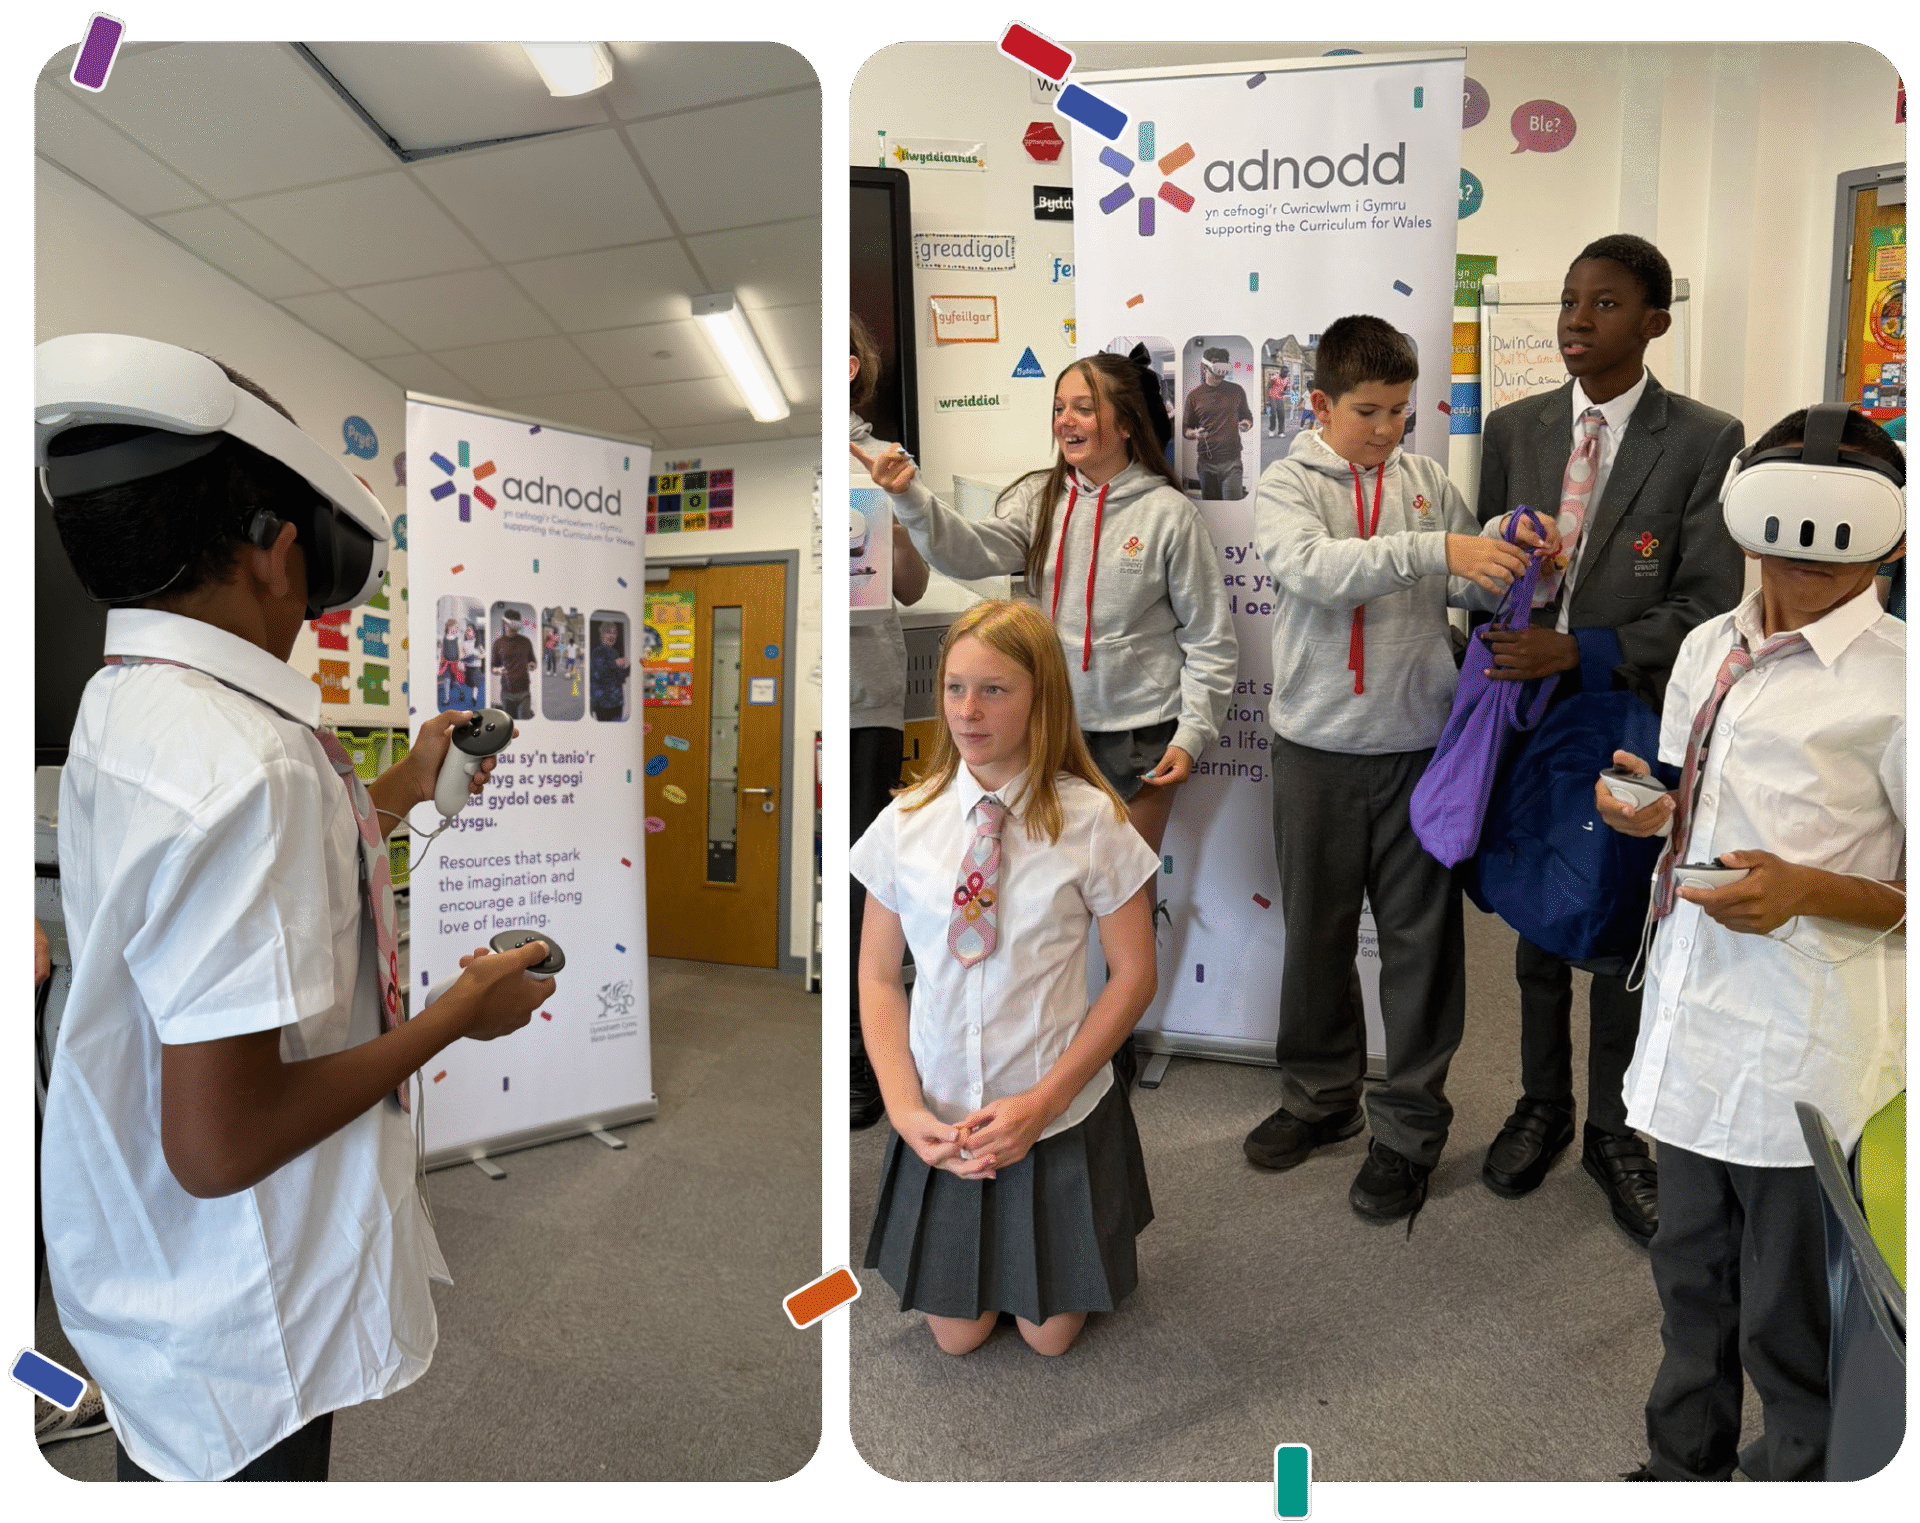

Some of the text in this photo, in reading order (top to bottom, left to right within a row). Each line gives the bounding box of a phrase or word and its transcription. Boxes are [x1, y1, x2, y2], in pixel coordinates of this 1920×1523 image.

[1530, 115, 1561, 133] Ble?
[1204, 142, 1406, 193] adnodd
[1205, 198, 1406, 221] yn cefnogi'r Cwricwlwm i Gymru
[1205, 215, 1433, 237] supporting the Curriculum for Wales
[920, 239, 1011, 262] greadigol
[938, 311, 991, 324] gyfeillgar
[939, 394, 1000, 408] wreiddiol
[1451, 403, 1479, 417] edyn
[503, 476, 622, 517] adnodd
[1223, 574, 1246, 587] ac
[1245, 602, 1275, 615] oe
[1233, 679, 1256, 695] at
[1220, 735, 1231, 748] a
[498, 750, 595, 767] au sy'n tanio'r
[519, 774, 535, 785] ac
[538, 771, 583, 788] ysgogi
[467, 791, 574, 810] ad gydol oes at
[439, 848, 581, 870] Resources that spark
[439, 868, 575, 892] the imagination and
[439, 889, 583, 913] encourage a life-long
[439, 912, 550, 934] love of learning.
